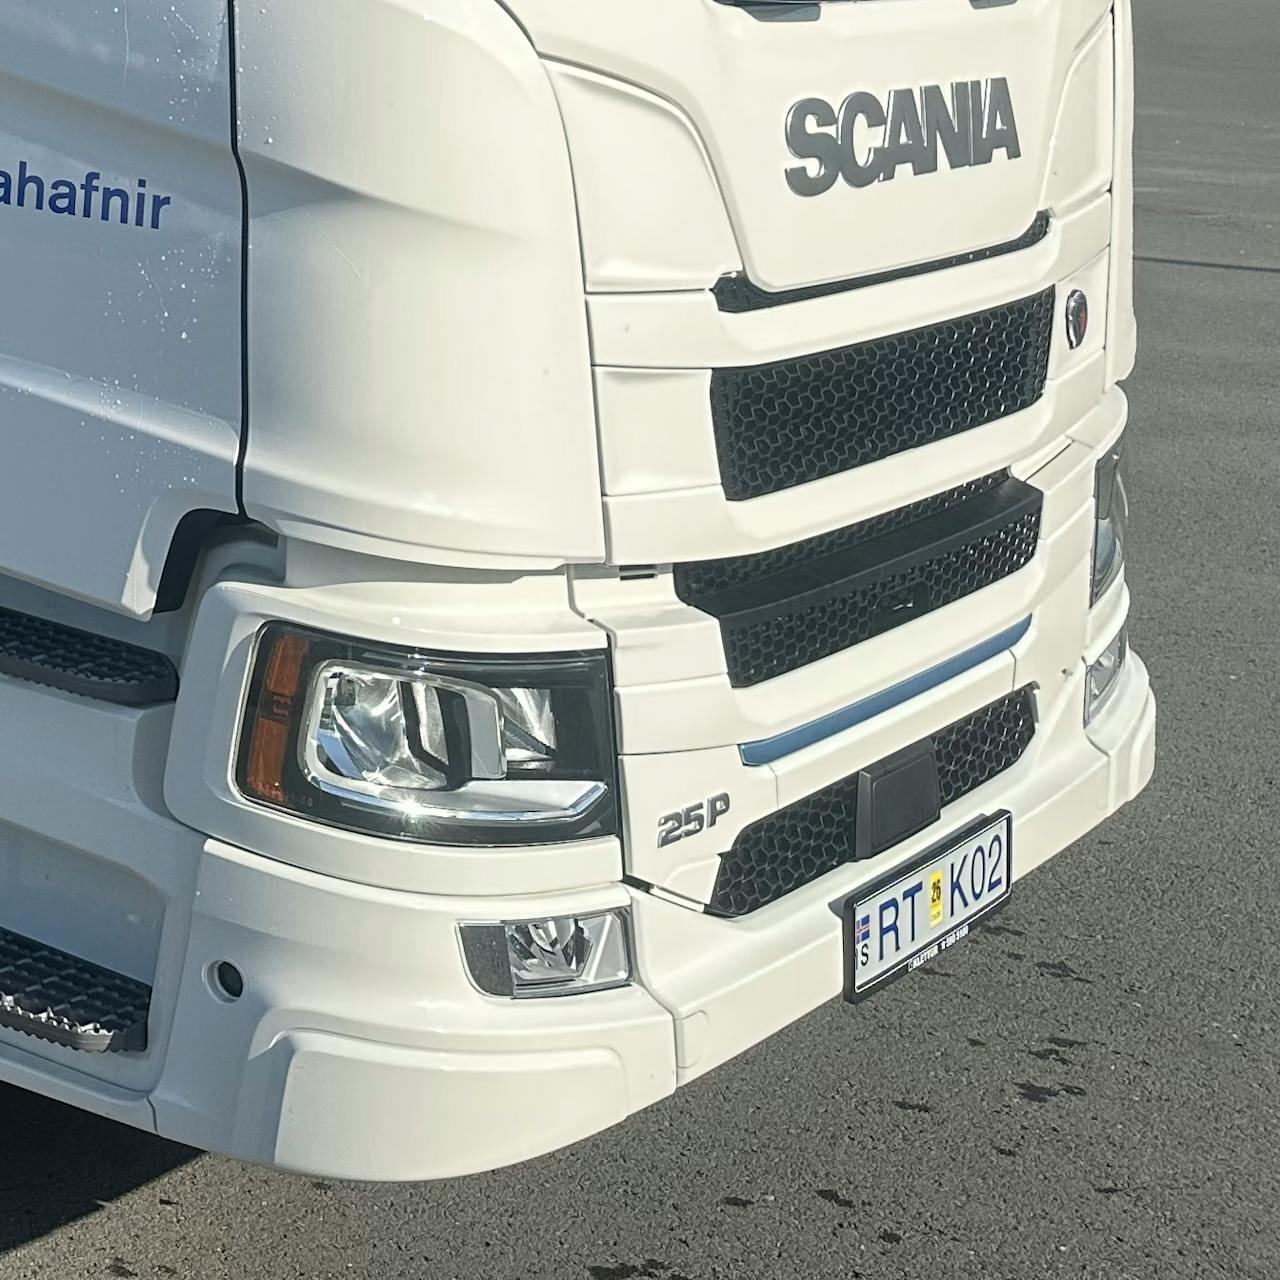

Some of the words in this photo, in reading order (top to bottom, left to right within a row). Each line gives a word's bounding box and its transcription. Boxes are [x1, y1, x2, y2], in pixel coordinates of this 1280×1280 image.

[785, 76, 1022, 198] SCANIA
[878, 880, 923, 962] RT
[949, 833, 1003, 918] K02
